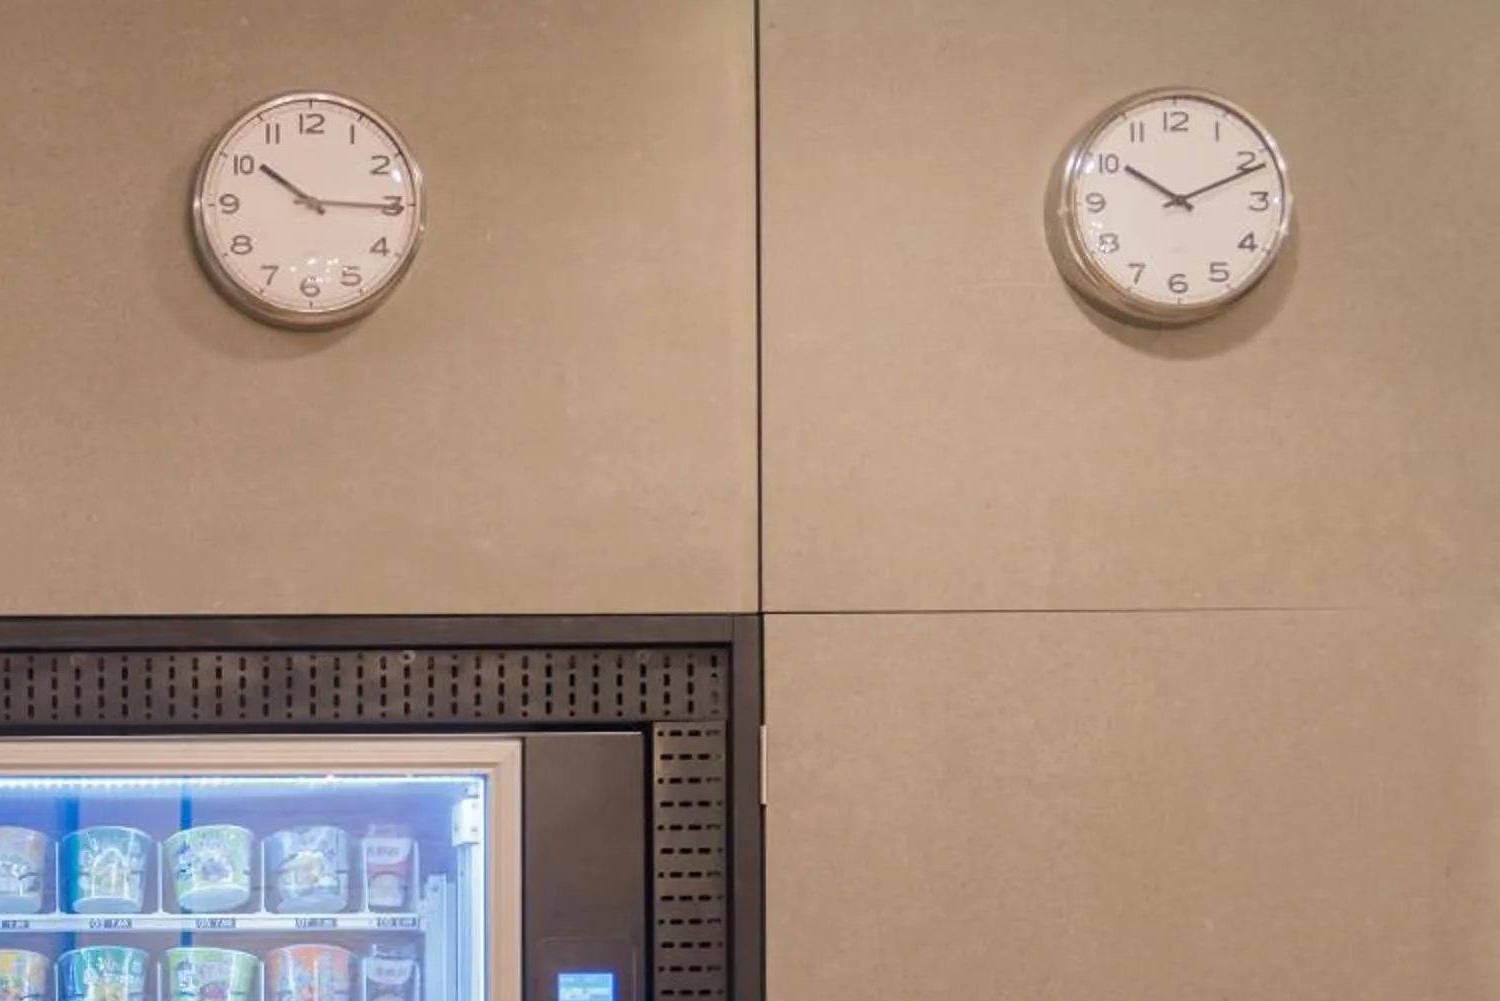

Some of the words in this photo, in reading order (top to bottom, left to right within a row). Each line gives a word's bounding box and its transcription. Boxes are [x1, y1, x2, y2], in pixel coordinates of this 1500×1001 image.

[299, 113, 325, 135] 12
[1130, 121, 1144, 143] 11
[1163, 111, 1189, 132] 12
[1215, 121, 1219, 142] 1
[266, 123, 280, 145] 11
[350, 124, 355, 145] 1
[233, 155, 254, 175] 10
[370, 155, 390, 175] 2
[1098, 153, 1119, 174] 10
[1236, 151, 1260, 173] 2
[219, 193, 240, 215] 9
[381, 195, 403, 217] 3
[1085, 192, 1106, 213] 9
[1249, 191, 1269, 212] 3
[230, 234, 253, 255] 8
[369, 236, 390, 257] 4
[1098, 232, 1120, 254] 8
[1238, 232, 1258, 253] 4
[260, 265, 279, 286] 7
[340, 265, 362, 287] 5
[1128, 262, 1146, 284] 7
[1209, 262, 1230, 283] 5
[299, 276, 321, 298] 6
[1168, 273, 1188, 295] 6
